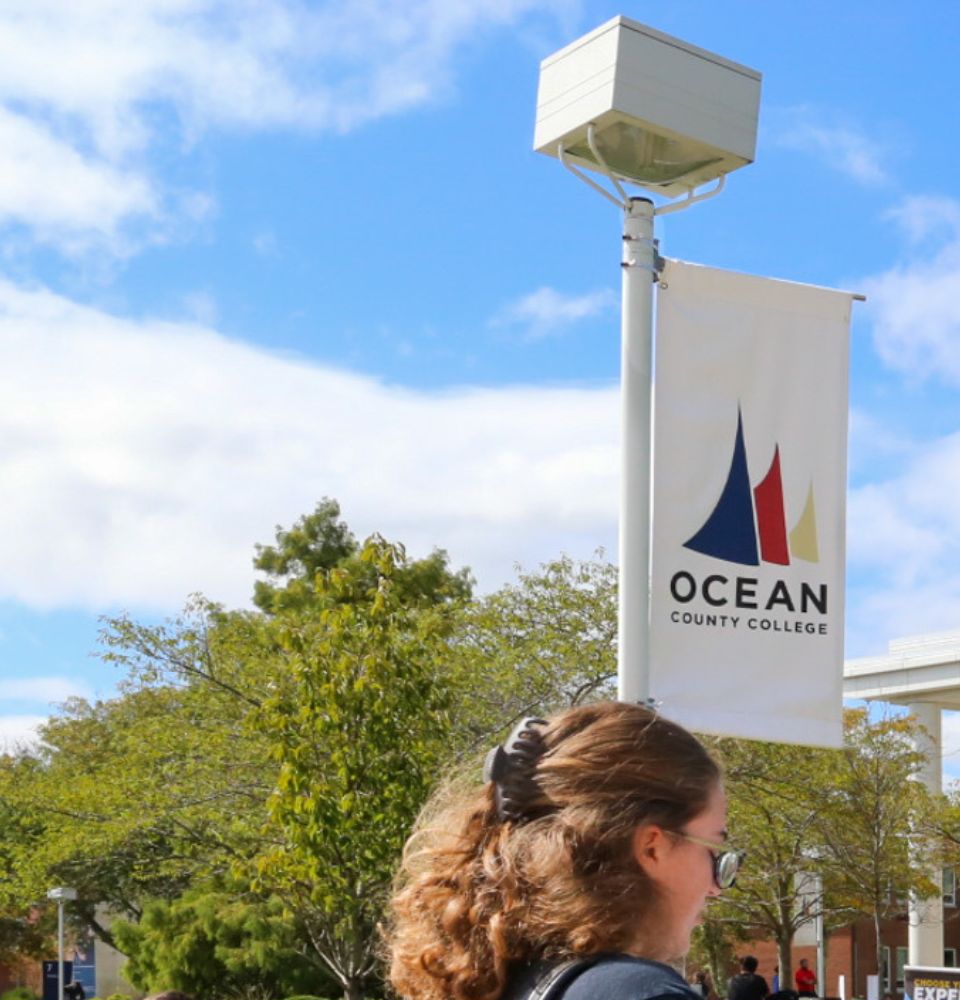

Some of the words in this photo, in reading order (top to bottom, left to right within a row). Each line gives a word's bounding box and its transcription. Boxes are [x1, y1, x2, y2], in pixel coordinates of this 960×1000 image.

[670, 570, 828, 615] OCEAN
[670, 611, 740, 629] COUNTY
[747, 618, 828, 635] COLLEGE
[914, 979, 949, 988] CHOOSE
